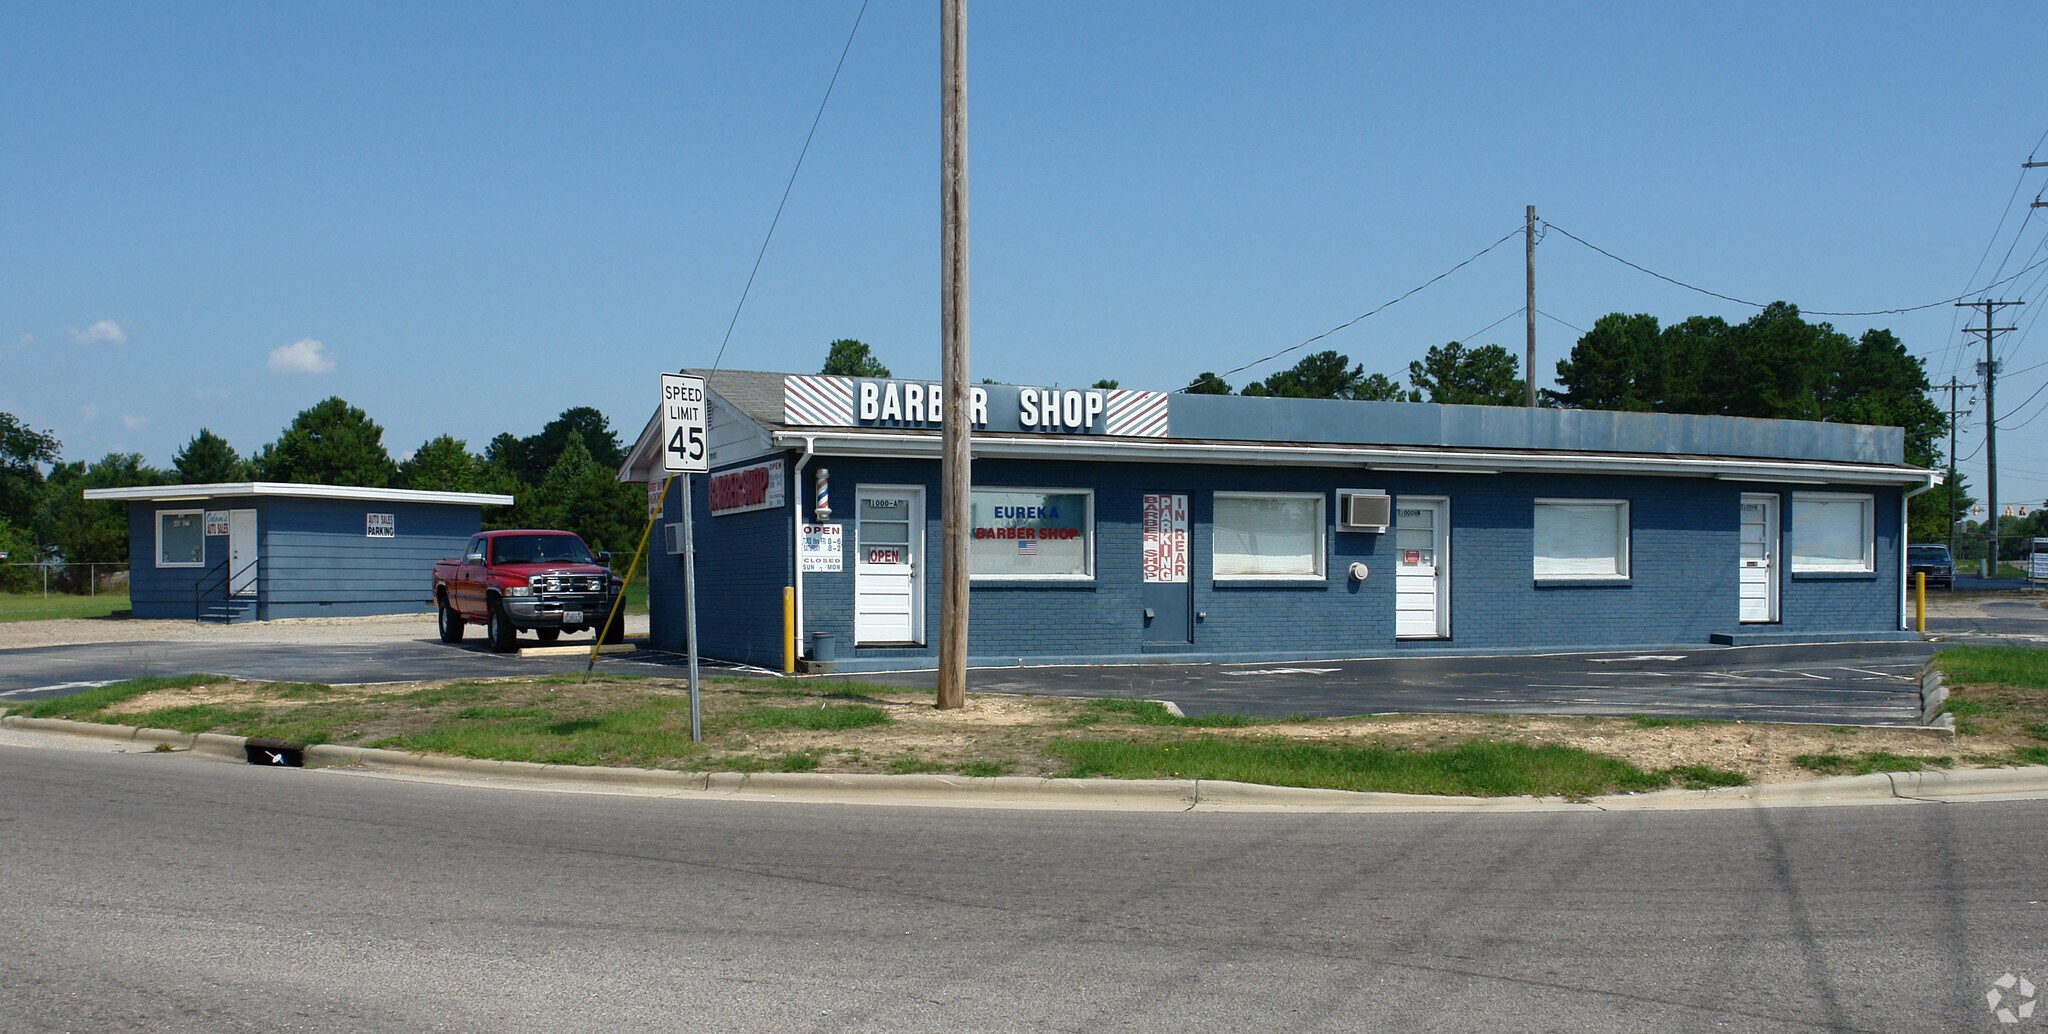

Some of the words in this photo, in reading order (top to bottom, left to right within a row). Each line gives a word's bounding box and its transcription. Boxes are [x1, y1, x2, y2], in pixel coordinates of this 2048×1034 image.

[665, 385, 702, 402] SPEED
[670, 406, 699, 421] LIMIT
[860, 382, 988, 425] BARBR
[1020, 388, 1103, 428] SHOP
[668, 426, 704, 461] 45
[994, 506, 1060, 519] EUREKA
[1144, 496, 1159, 542] BARBER
[1174, 498, 1185, 522] IN
[368, 526, 394, 537] PARKING
[803, 526, 840, 535] OPEN
[975, 527, 1036, 540] BARBER
[1038, 527, 1080, 540] SHOP
[1160, 497, 1172, 581] PARKING
[870, 550, 899, 563] OPEN
[1174, 528, 1185, 577] REAR
[1144, 549, 1159, 580] SHOP
